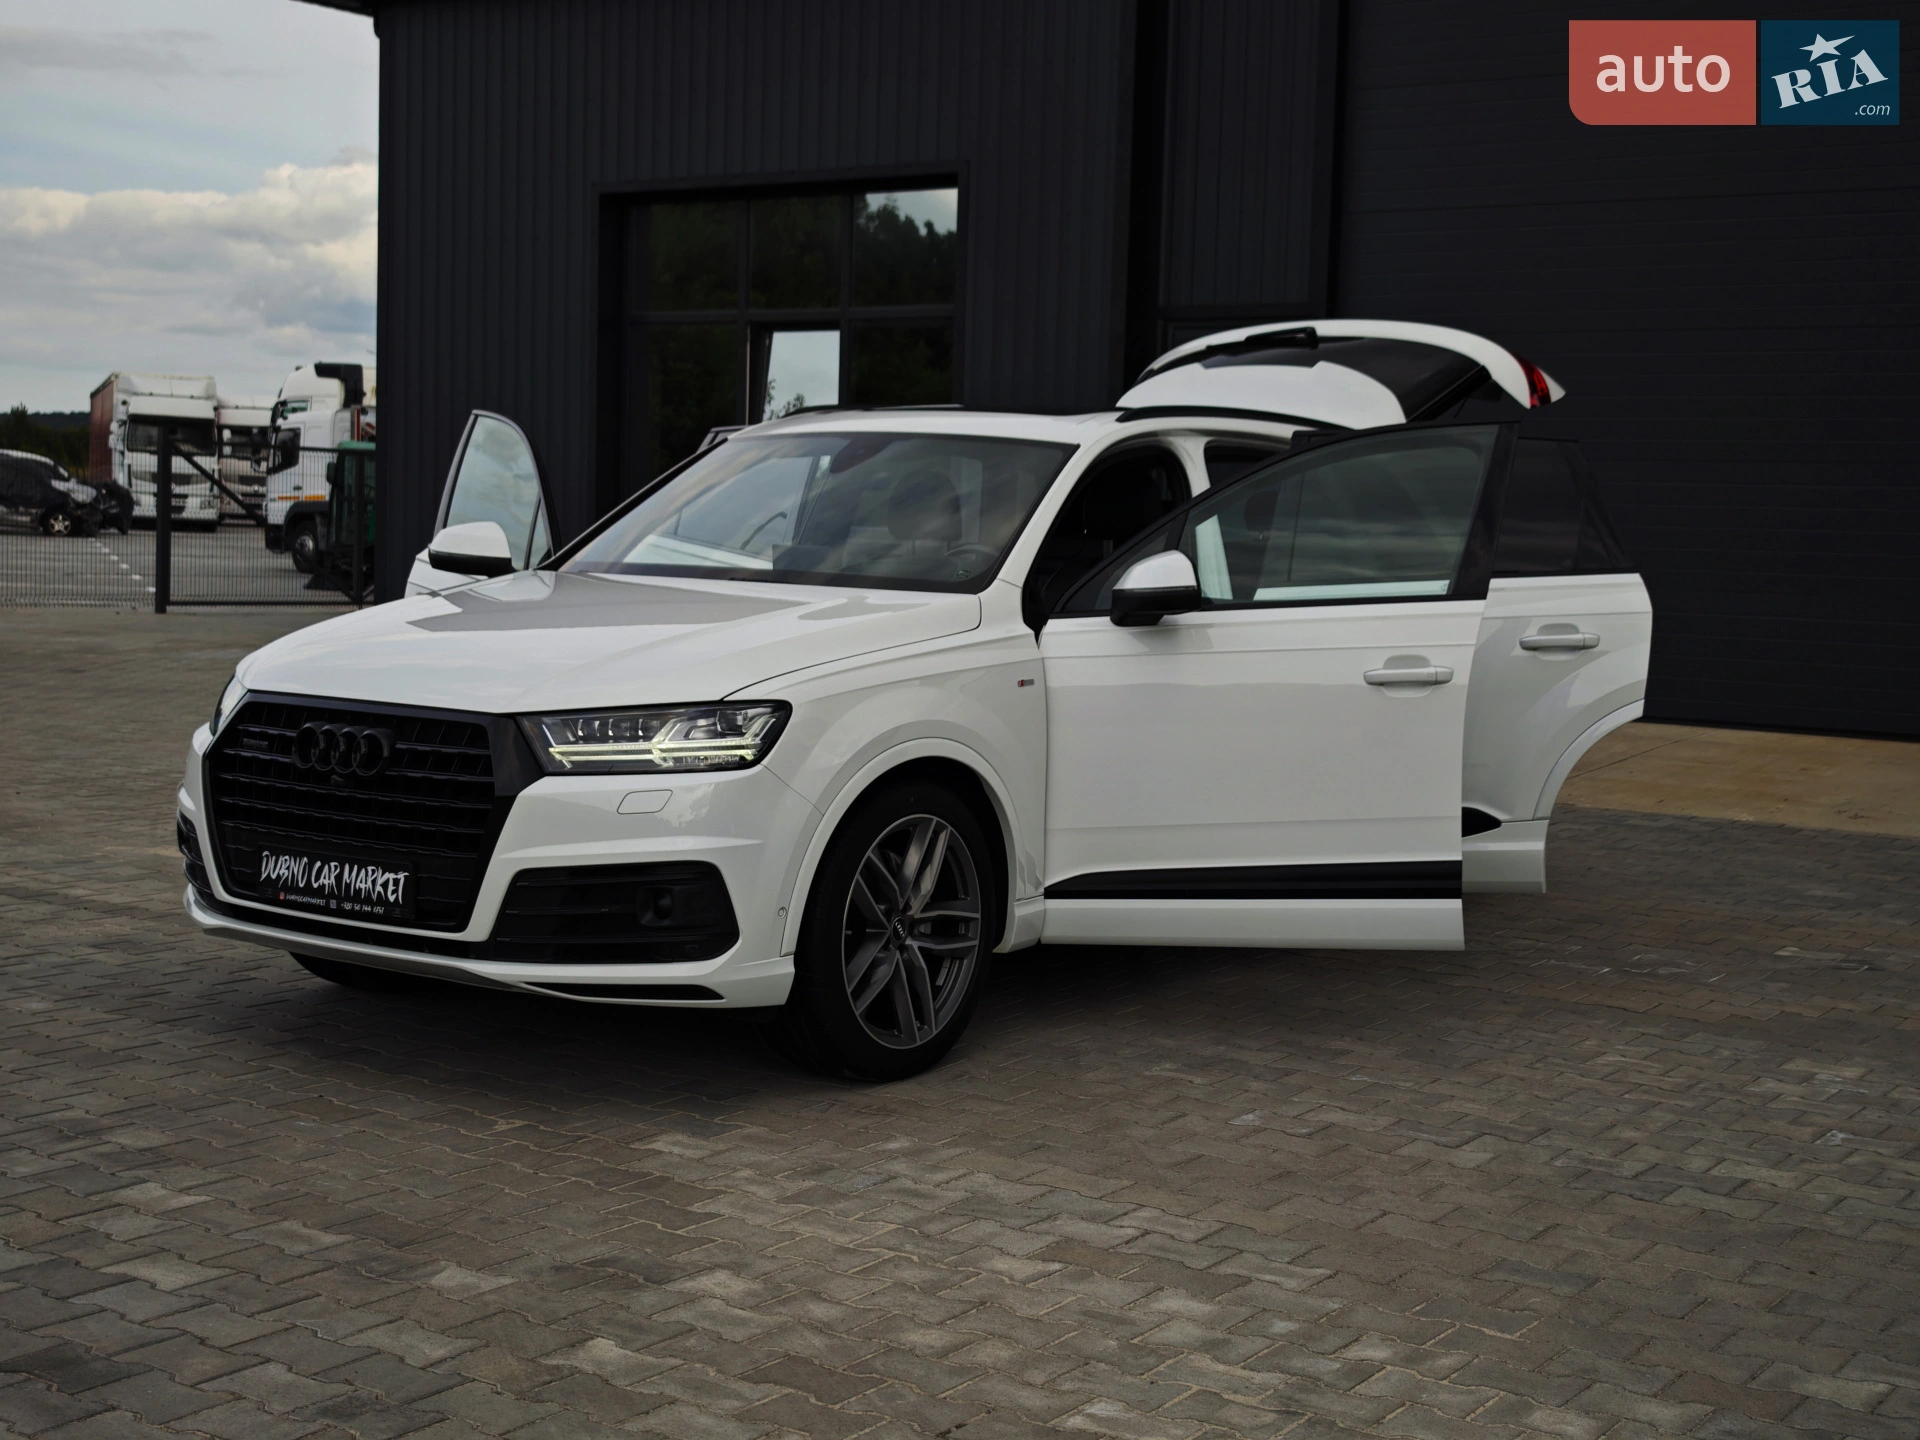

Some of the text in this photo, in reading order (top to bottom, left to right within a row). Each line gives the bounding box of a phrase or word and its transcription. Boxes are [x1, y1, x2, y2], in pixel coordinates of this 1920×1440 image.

[260, 850, 410, 905] DUBNO CAR MARKET
